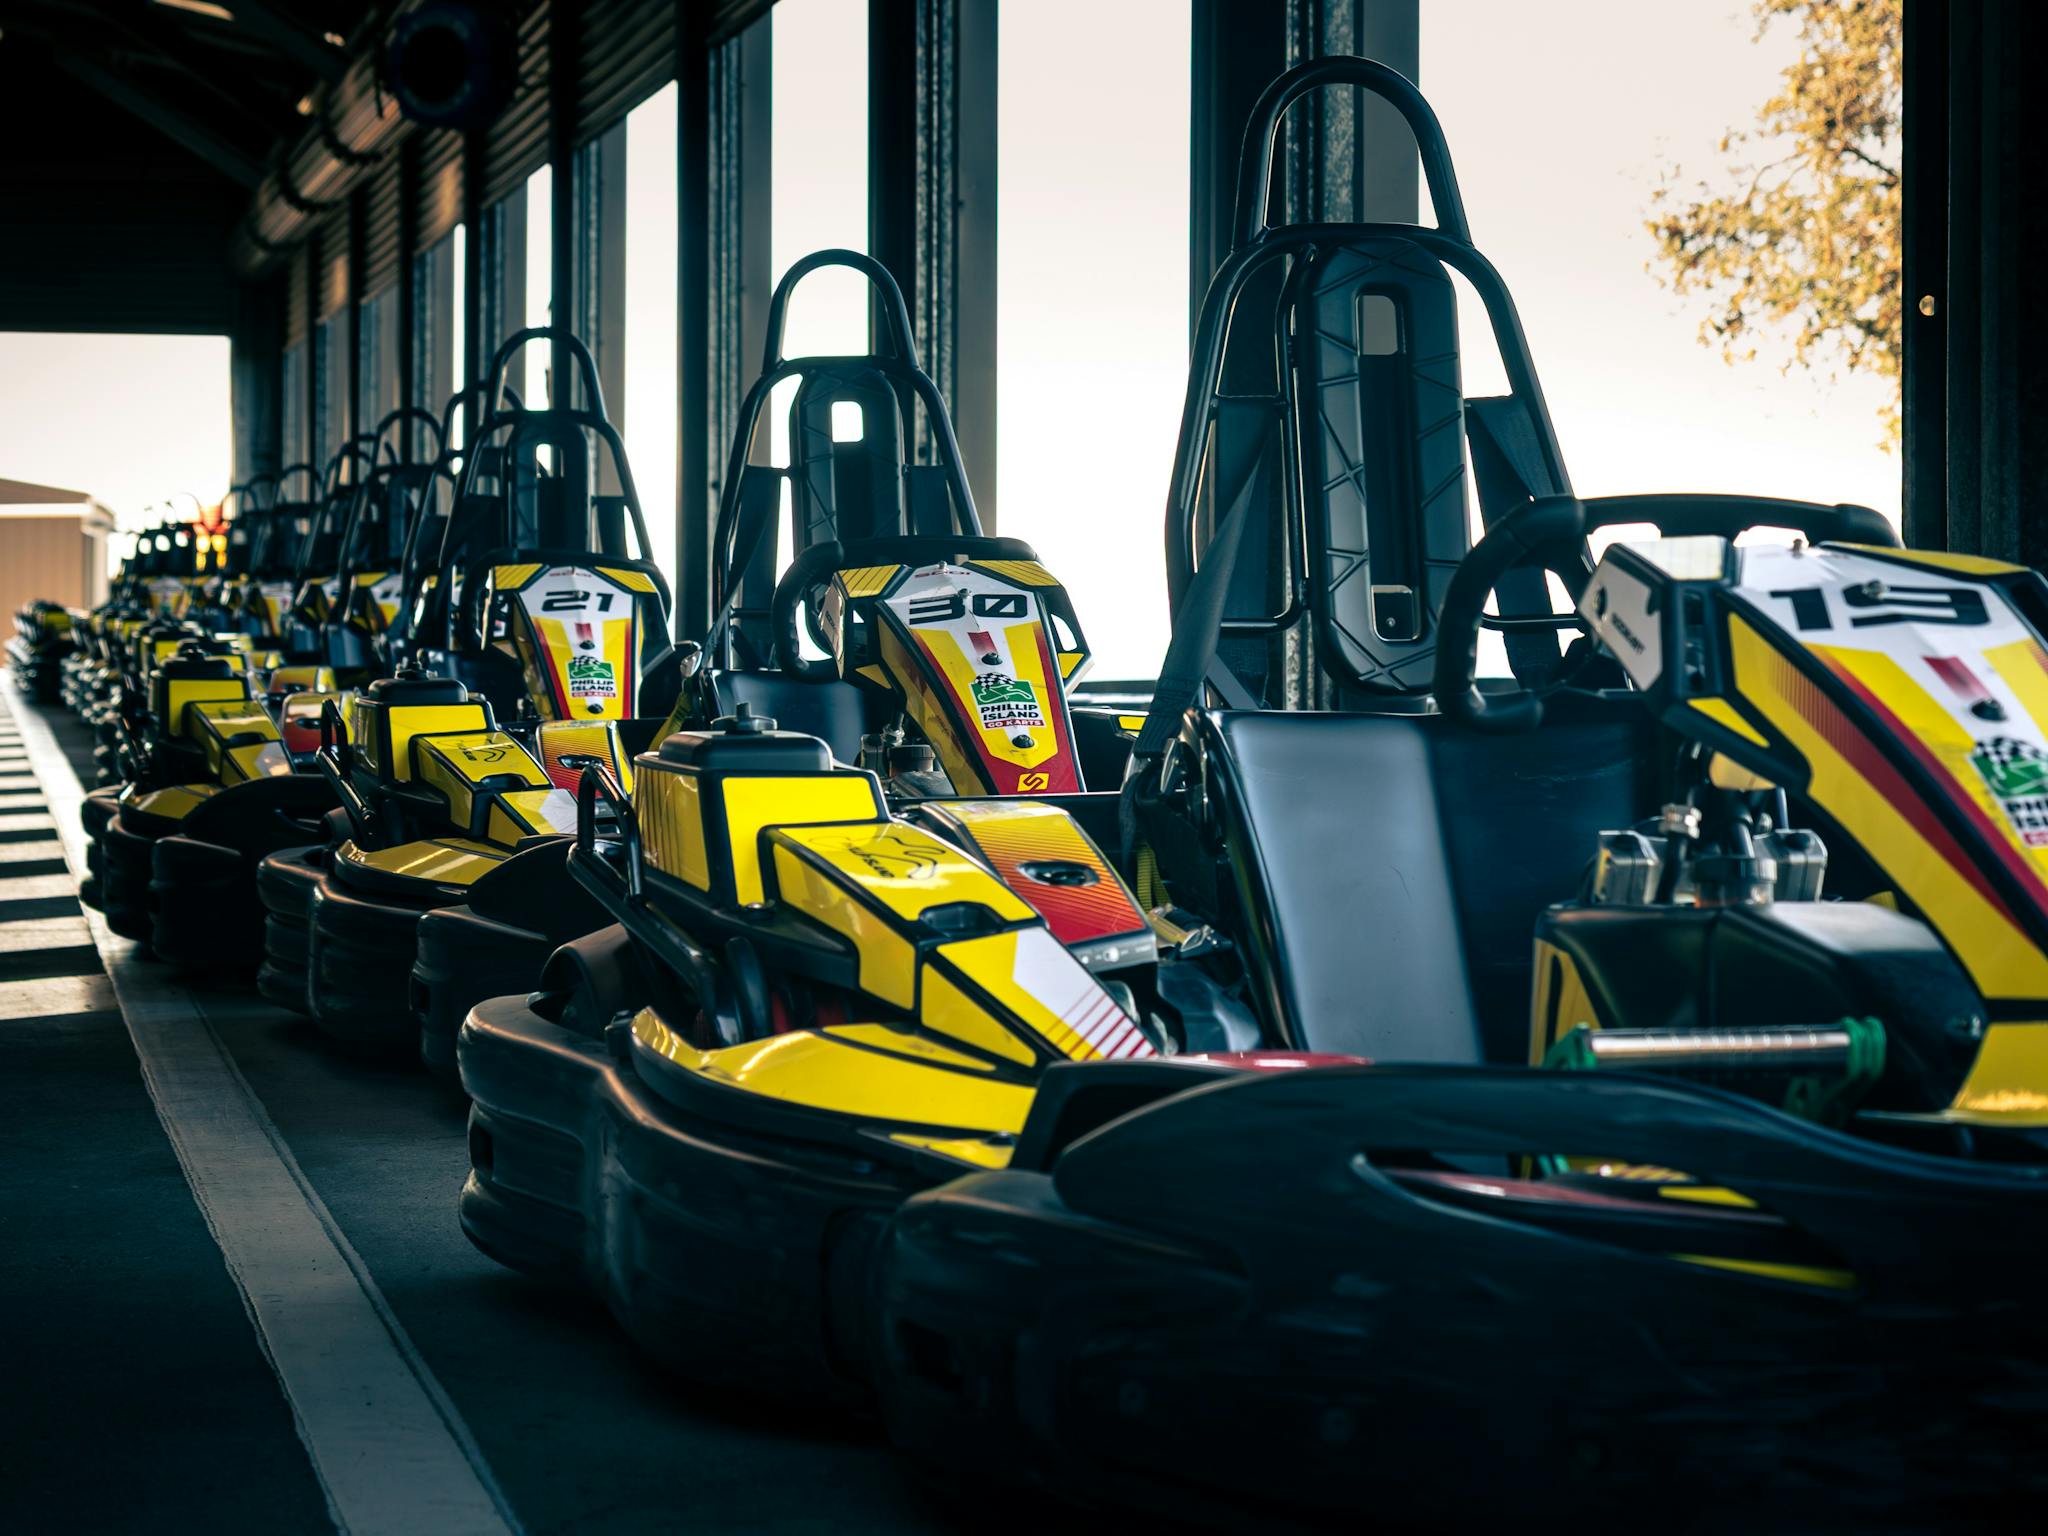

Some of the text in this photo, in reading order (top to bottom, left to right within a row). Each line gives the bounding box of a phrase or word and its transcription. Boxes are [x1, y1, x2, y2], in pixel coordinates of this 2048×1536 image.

[542, 590, 614, 612] 21
[1769, 583, 1991, 631] 19
[909, 594, 1028, 625] 30
[980, 704, 1038, 713] PHILLIP
[983, 711, 1039, 721] ISLAND
[1006, 719, 1041, 727] KARTS
